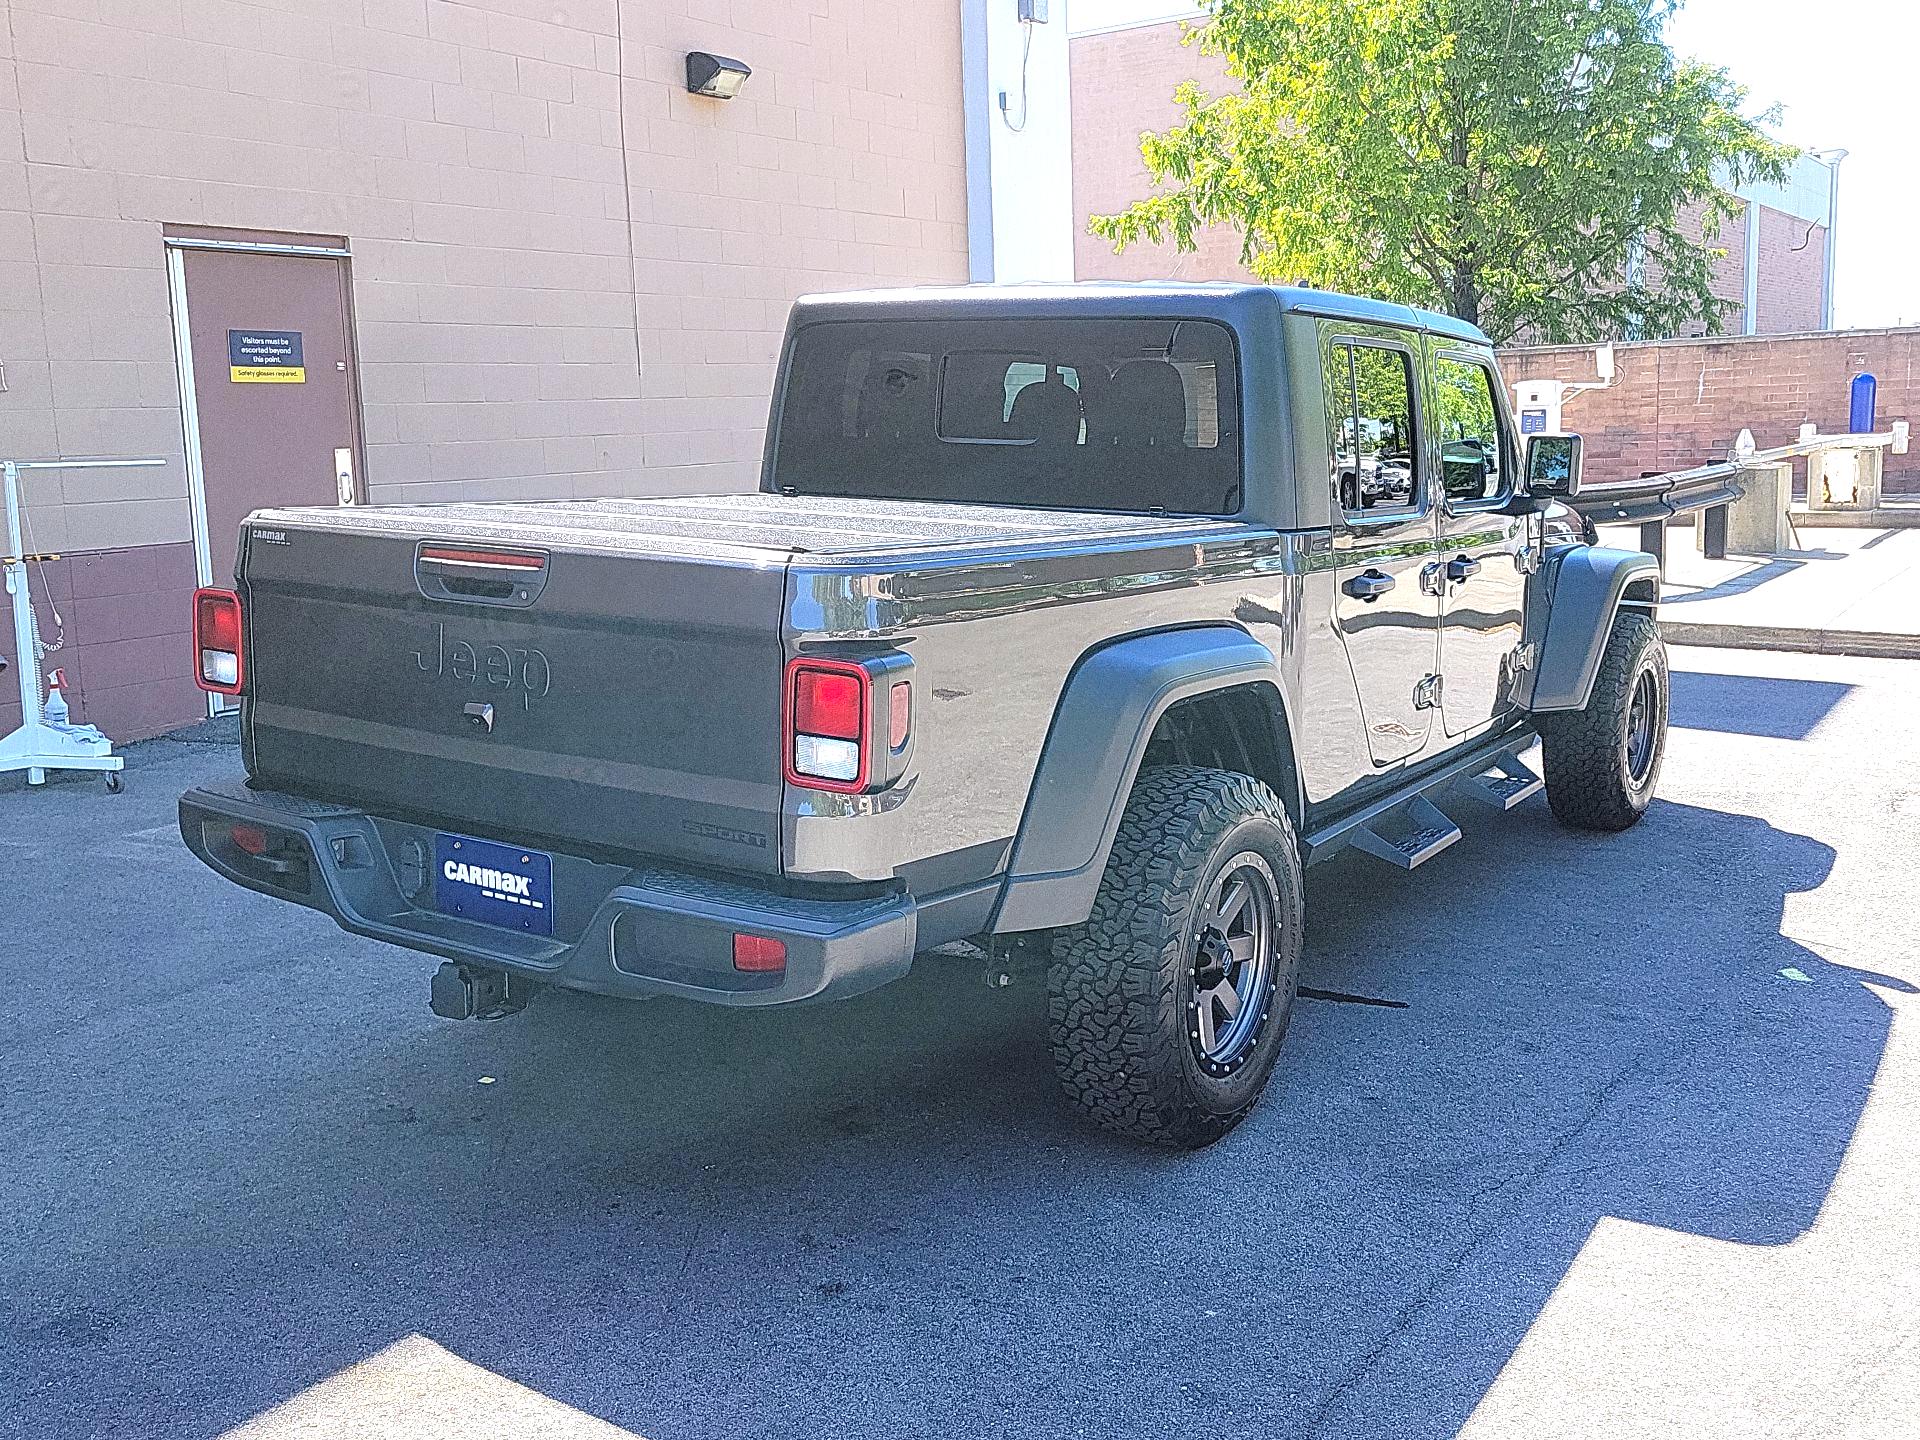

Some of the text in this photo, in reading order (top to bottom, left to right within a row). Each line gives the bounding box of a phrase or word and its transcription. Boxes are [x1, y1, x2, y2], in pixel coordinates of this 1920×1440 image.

[269, 347, 291, 355] beyond
[265, 356, 282, 364] point.
[409, 621, 550, 711] Jeep
